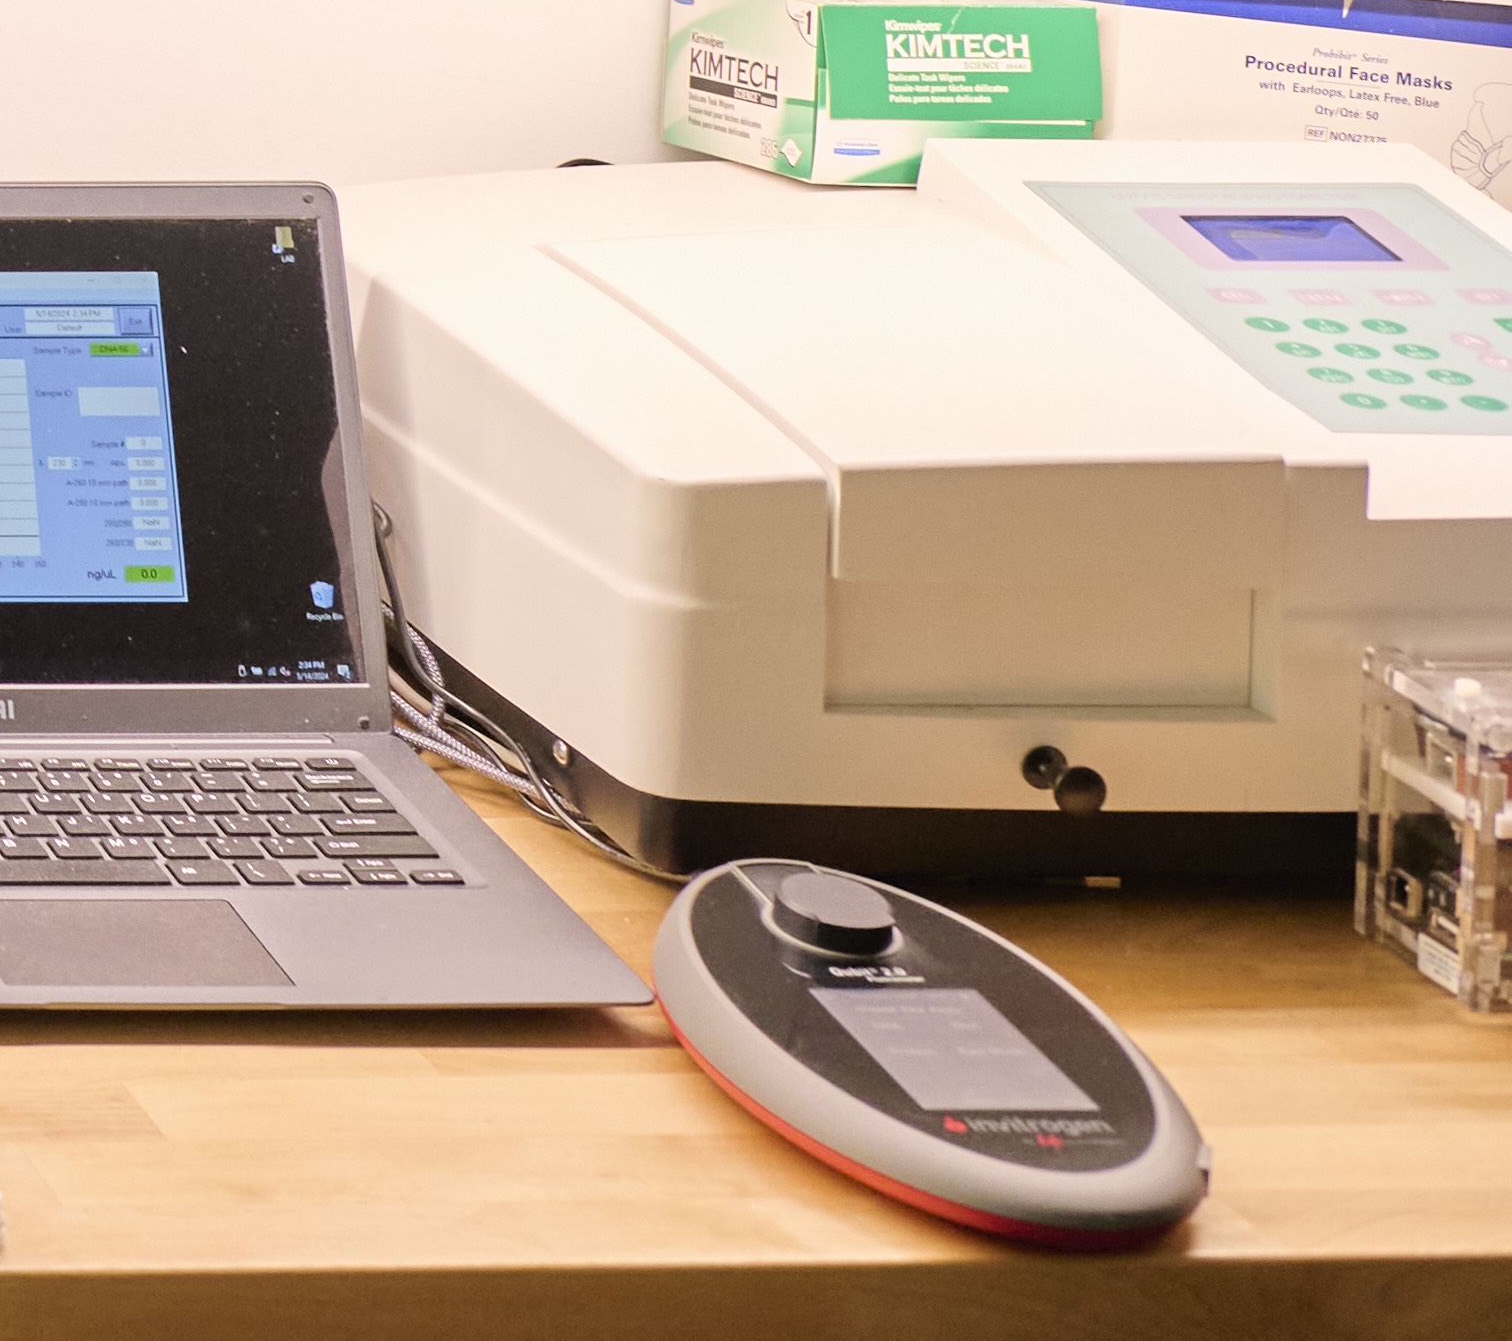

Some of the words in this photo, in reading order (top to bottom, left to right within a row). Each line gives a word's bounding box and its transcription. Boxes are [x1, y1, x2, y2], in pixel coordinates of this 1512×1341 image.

[884, 19, 942, 33] Kimwipes
[691, 32, 725, 50] Kimwipes
[885, 33, 1031, 59] KIMTECH
[690, 47, 780, 93] KIMTECH
[889, 73, 918, 82] Delicate
[921, 73, 937, 83] Task
[939, 73, 966, 84] Wipers
[1245, 54, 1343, 80] Procedural
[1349, 65, 1390, 84] Face
[1396, 70, 1454, 92] Masks
[1258, 79, 1285, 92] with
[1291, 82, 1345, 101] Earloops,
[1348, 87, 1380, 103] Latex
[1383, 91, 1412, 106] Free,
[1414, 95, 1441, 109] Blue
[1366, 109, 1379, 122] 50
[87, 568, 116, 581] ng/uL
[141, 568, 158, 579] 0.0
[965, 1116, 1114, 1137] invitrogen
